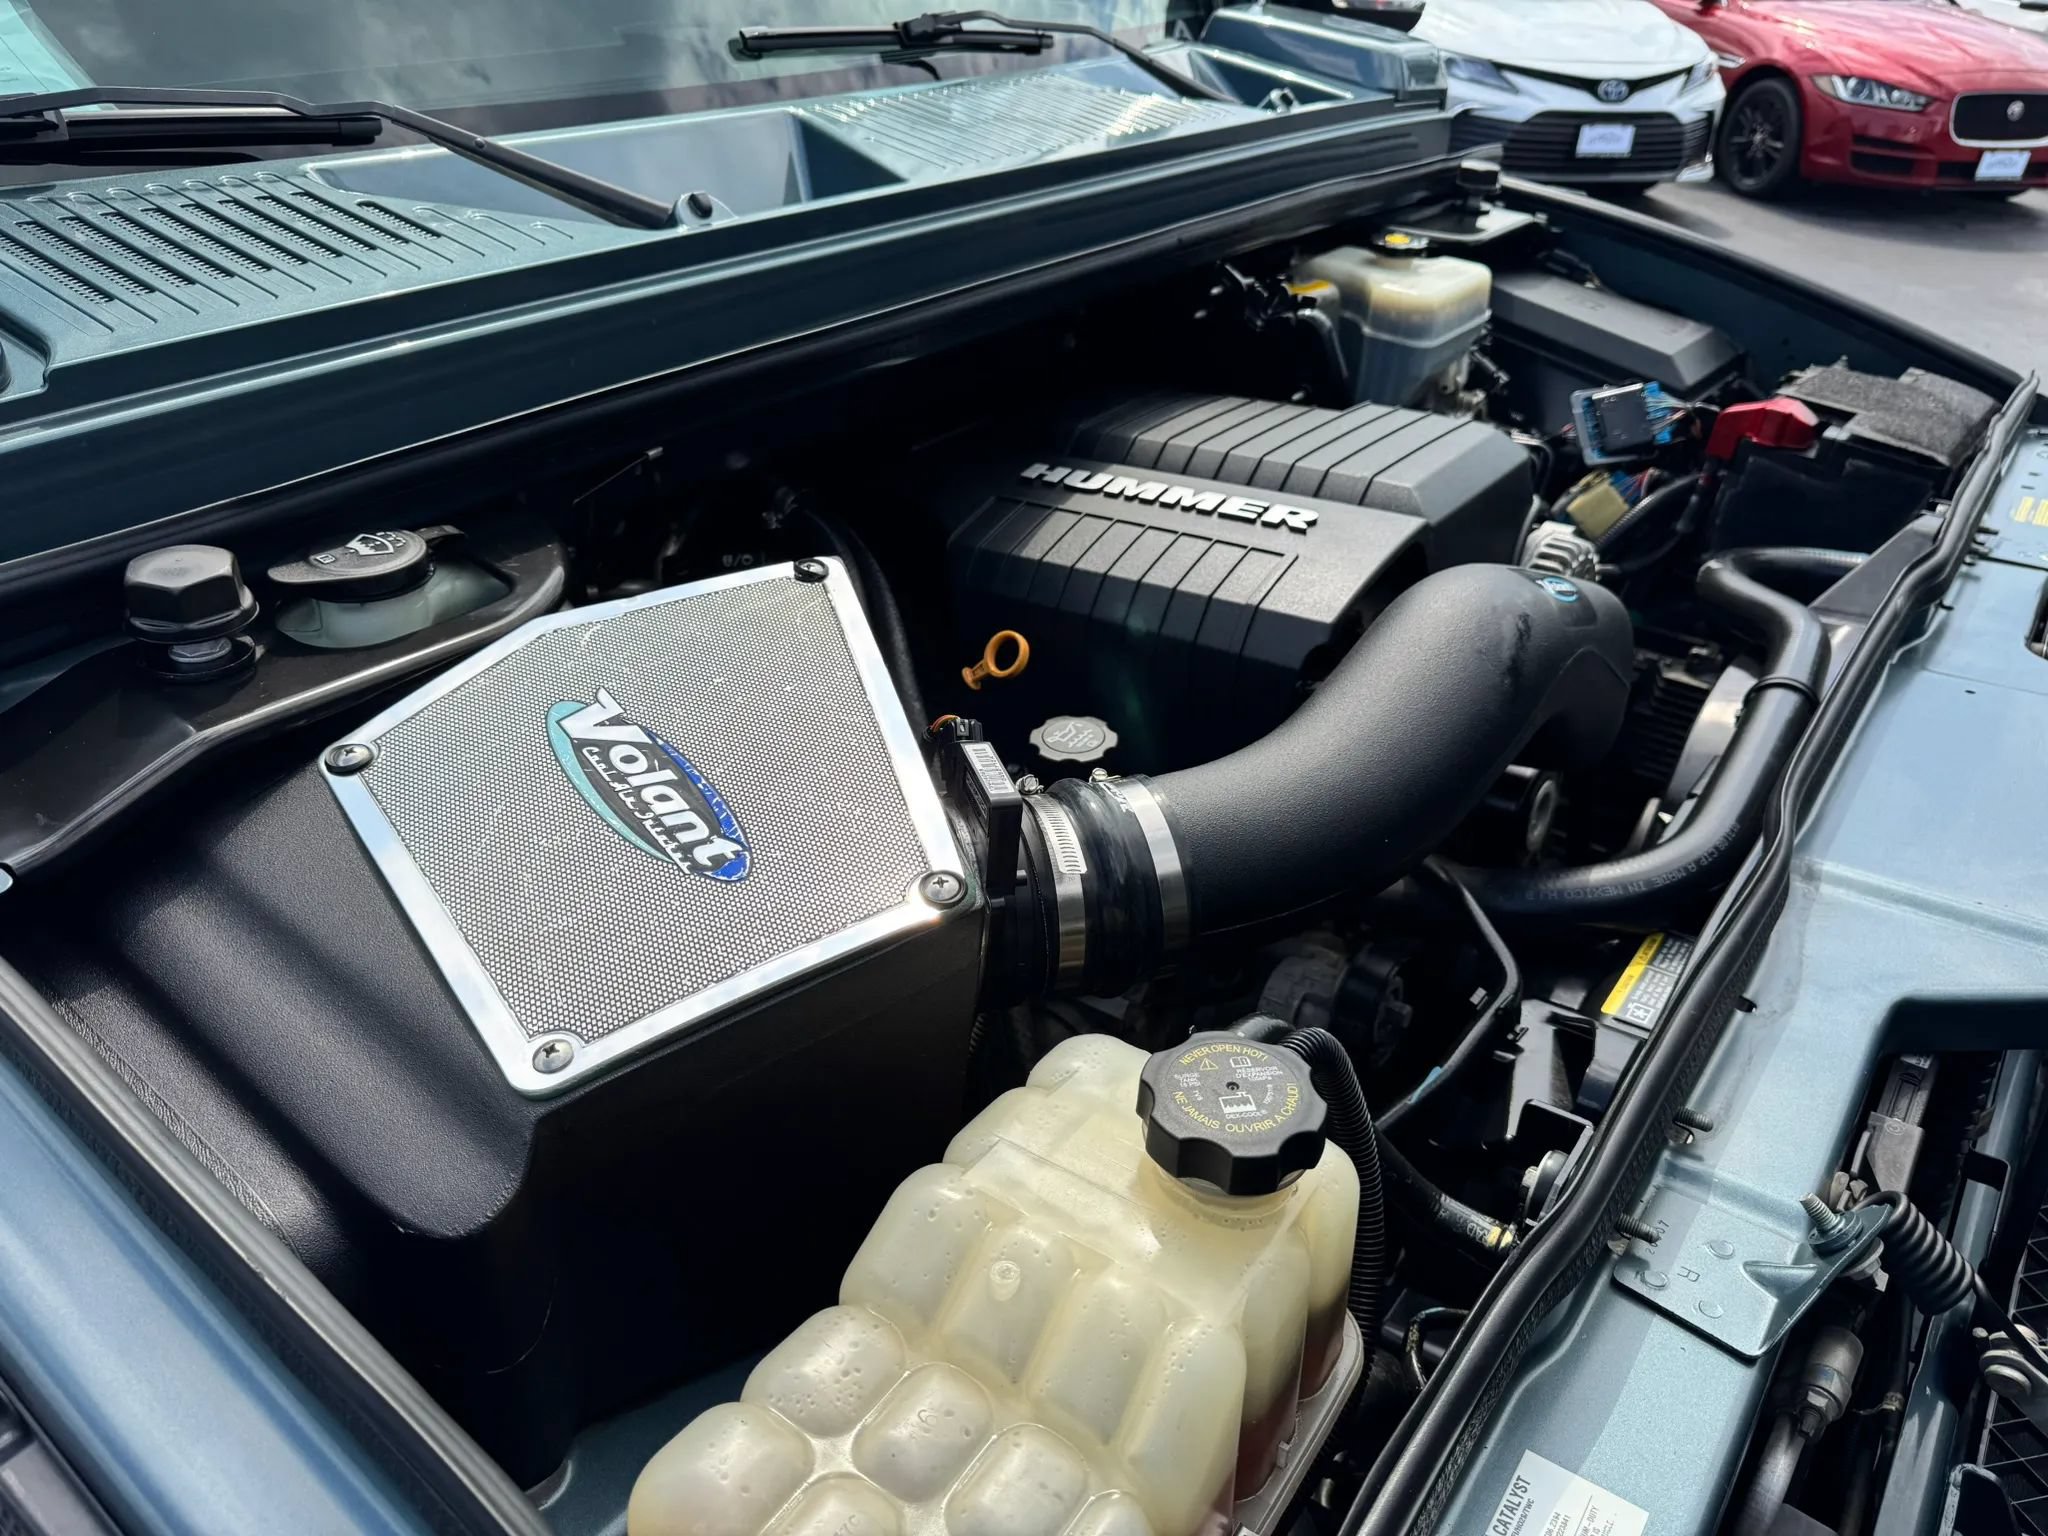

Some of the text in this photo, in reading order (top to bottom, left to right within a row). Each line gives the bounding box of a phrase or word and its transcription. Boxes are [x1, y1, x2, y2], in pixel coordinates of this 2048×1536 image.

[1020, 463, 1319, 532] HUMMER
[556, 687, 743, 867] Volant
[1563, 883, 1624, 899] MEXICO
[1179, 1044, 1269, 1065] NEVER OPEN HOT!
[1173, 1091, 1188, 1106] NE
[1182, 1105, 1221, 1129] JAMAIS
[1225, 1118, 1276, 1133] OUVRIR
[1492, 1475, 1531, 1536] CATALYST
